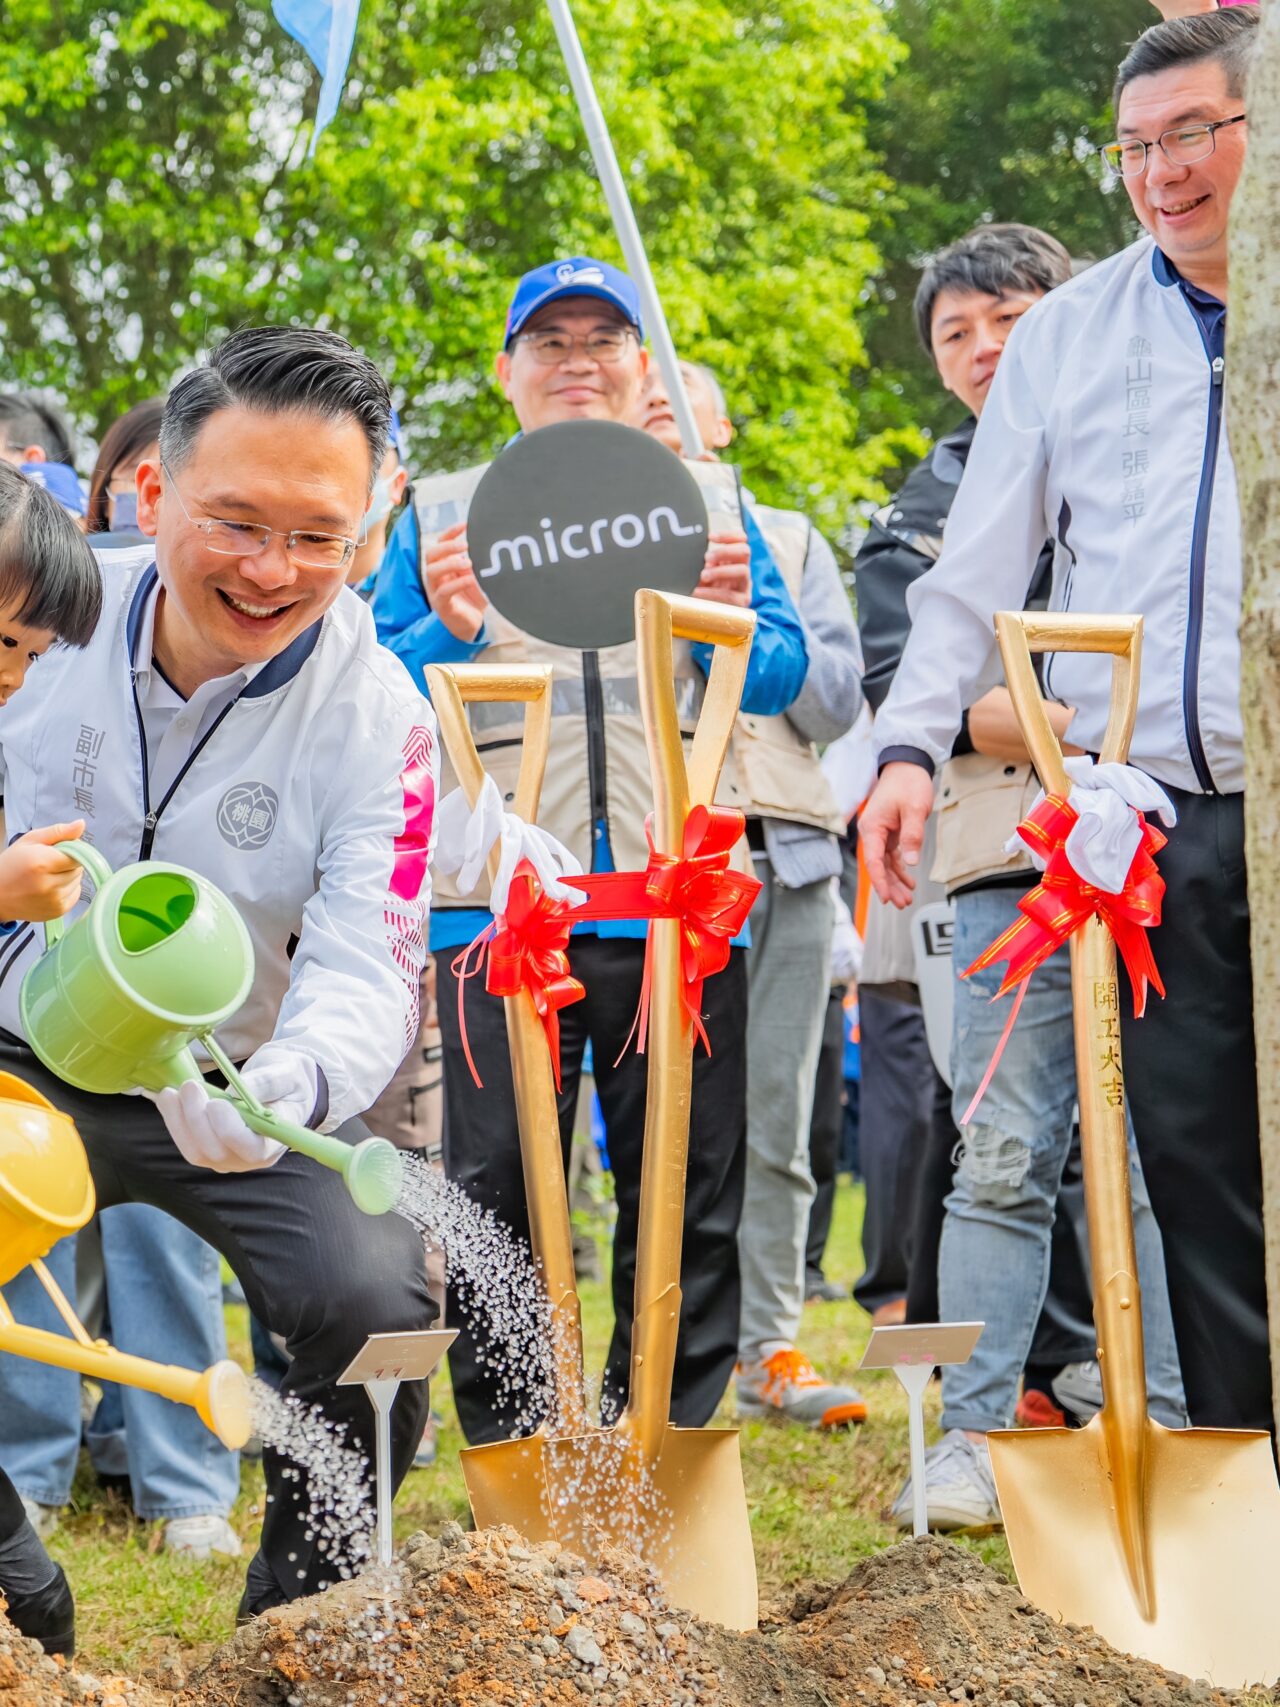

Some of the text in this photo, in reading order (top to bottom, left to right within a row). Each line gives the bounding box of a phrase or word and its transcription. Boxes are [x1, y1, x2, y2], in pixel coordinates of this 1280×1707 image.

[231, 801, 270, 832] 桃園
[1094, 982, 1123, 1108] 開工大吉
